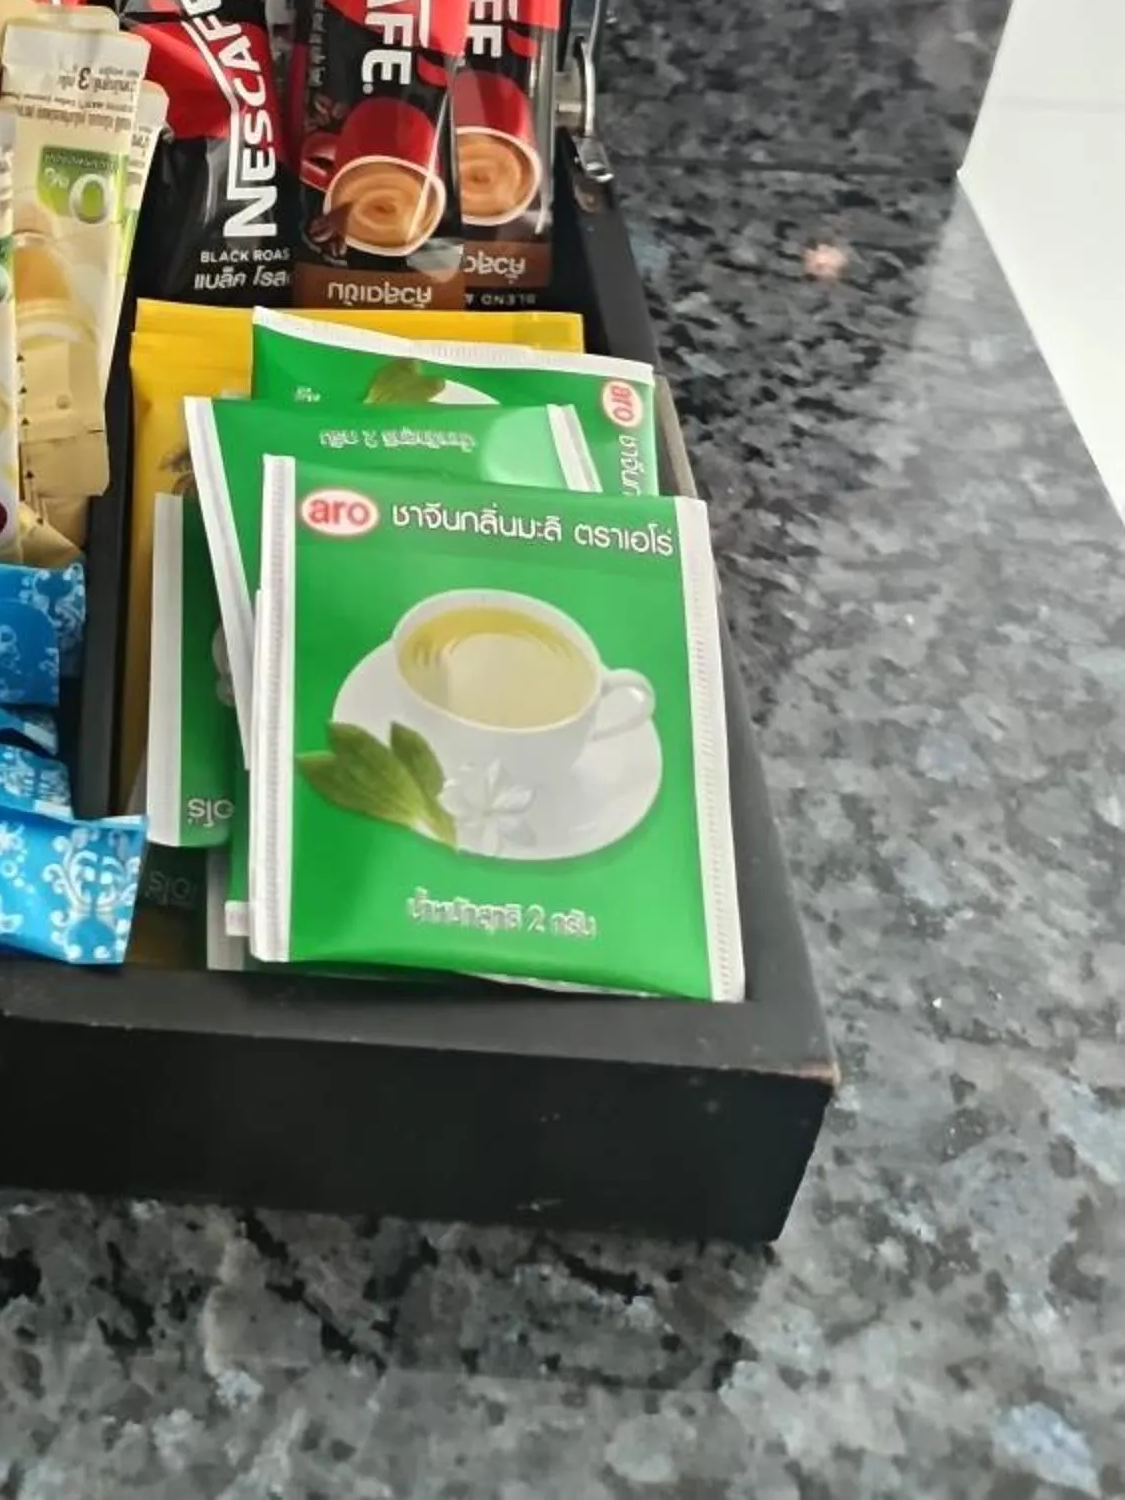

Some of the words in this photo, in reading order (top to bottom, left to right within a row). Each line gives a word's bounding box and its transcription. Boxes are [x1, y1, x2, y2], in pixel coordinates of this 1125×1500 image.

[78, 67, 91, 91] 3
[200, 250, 249, 263] BLACK
[253, 248, 290, 262] ROAS
[194, 266, 246, 290] แบล็ค
[308, 498, 371, 527] aro
[393, 501, 562, 542] ชาจีนกลิ่นมะลิ
[574, 522, 673, 556] ตราเอโร่
[406, 886, 523, 936] น้ำหนักสุทธิ
[527, 904, 545, 933] 2
[551, 908, 596, 940] กรัม
